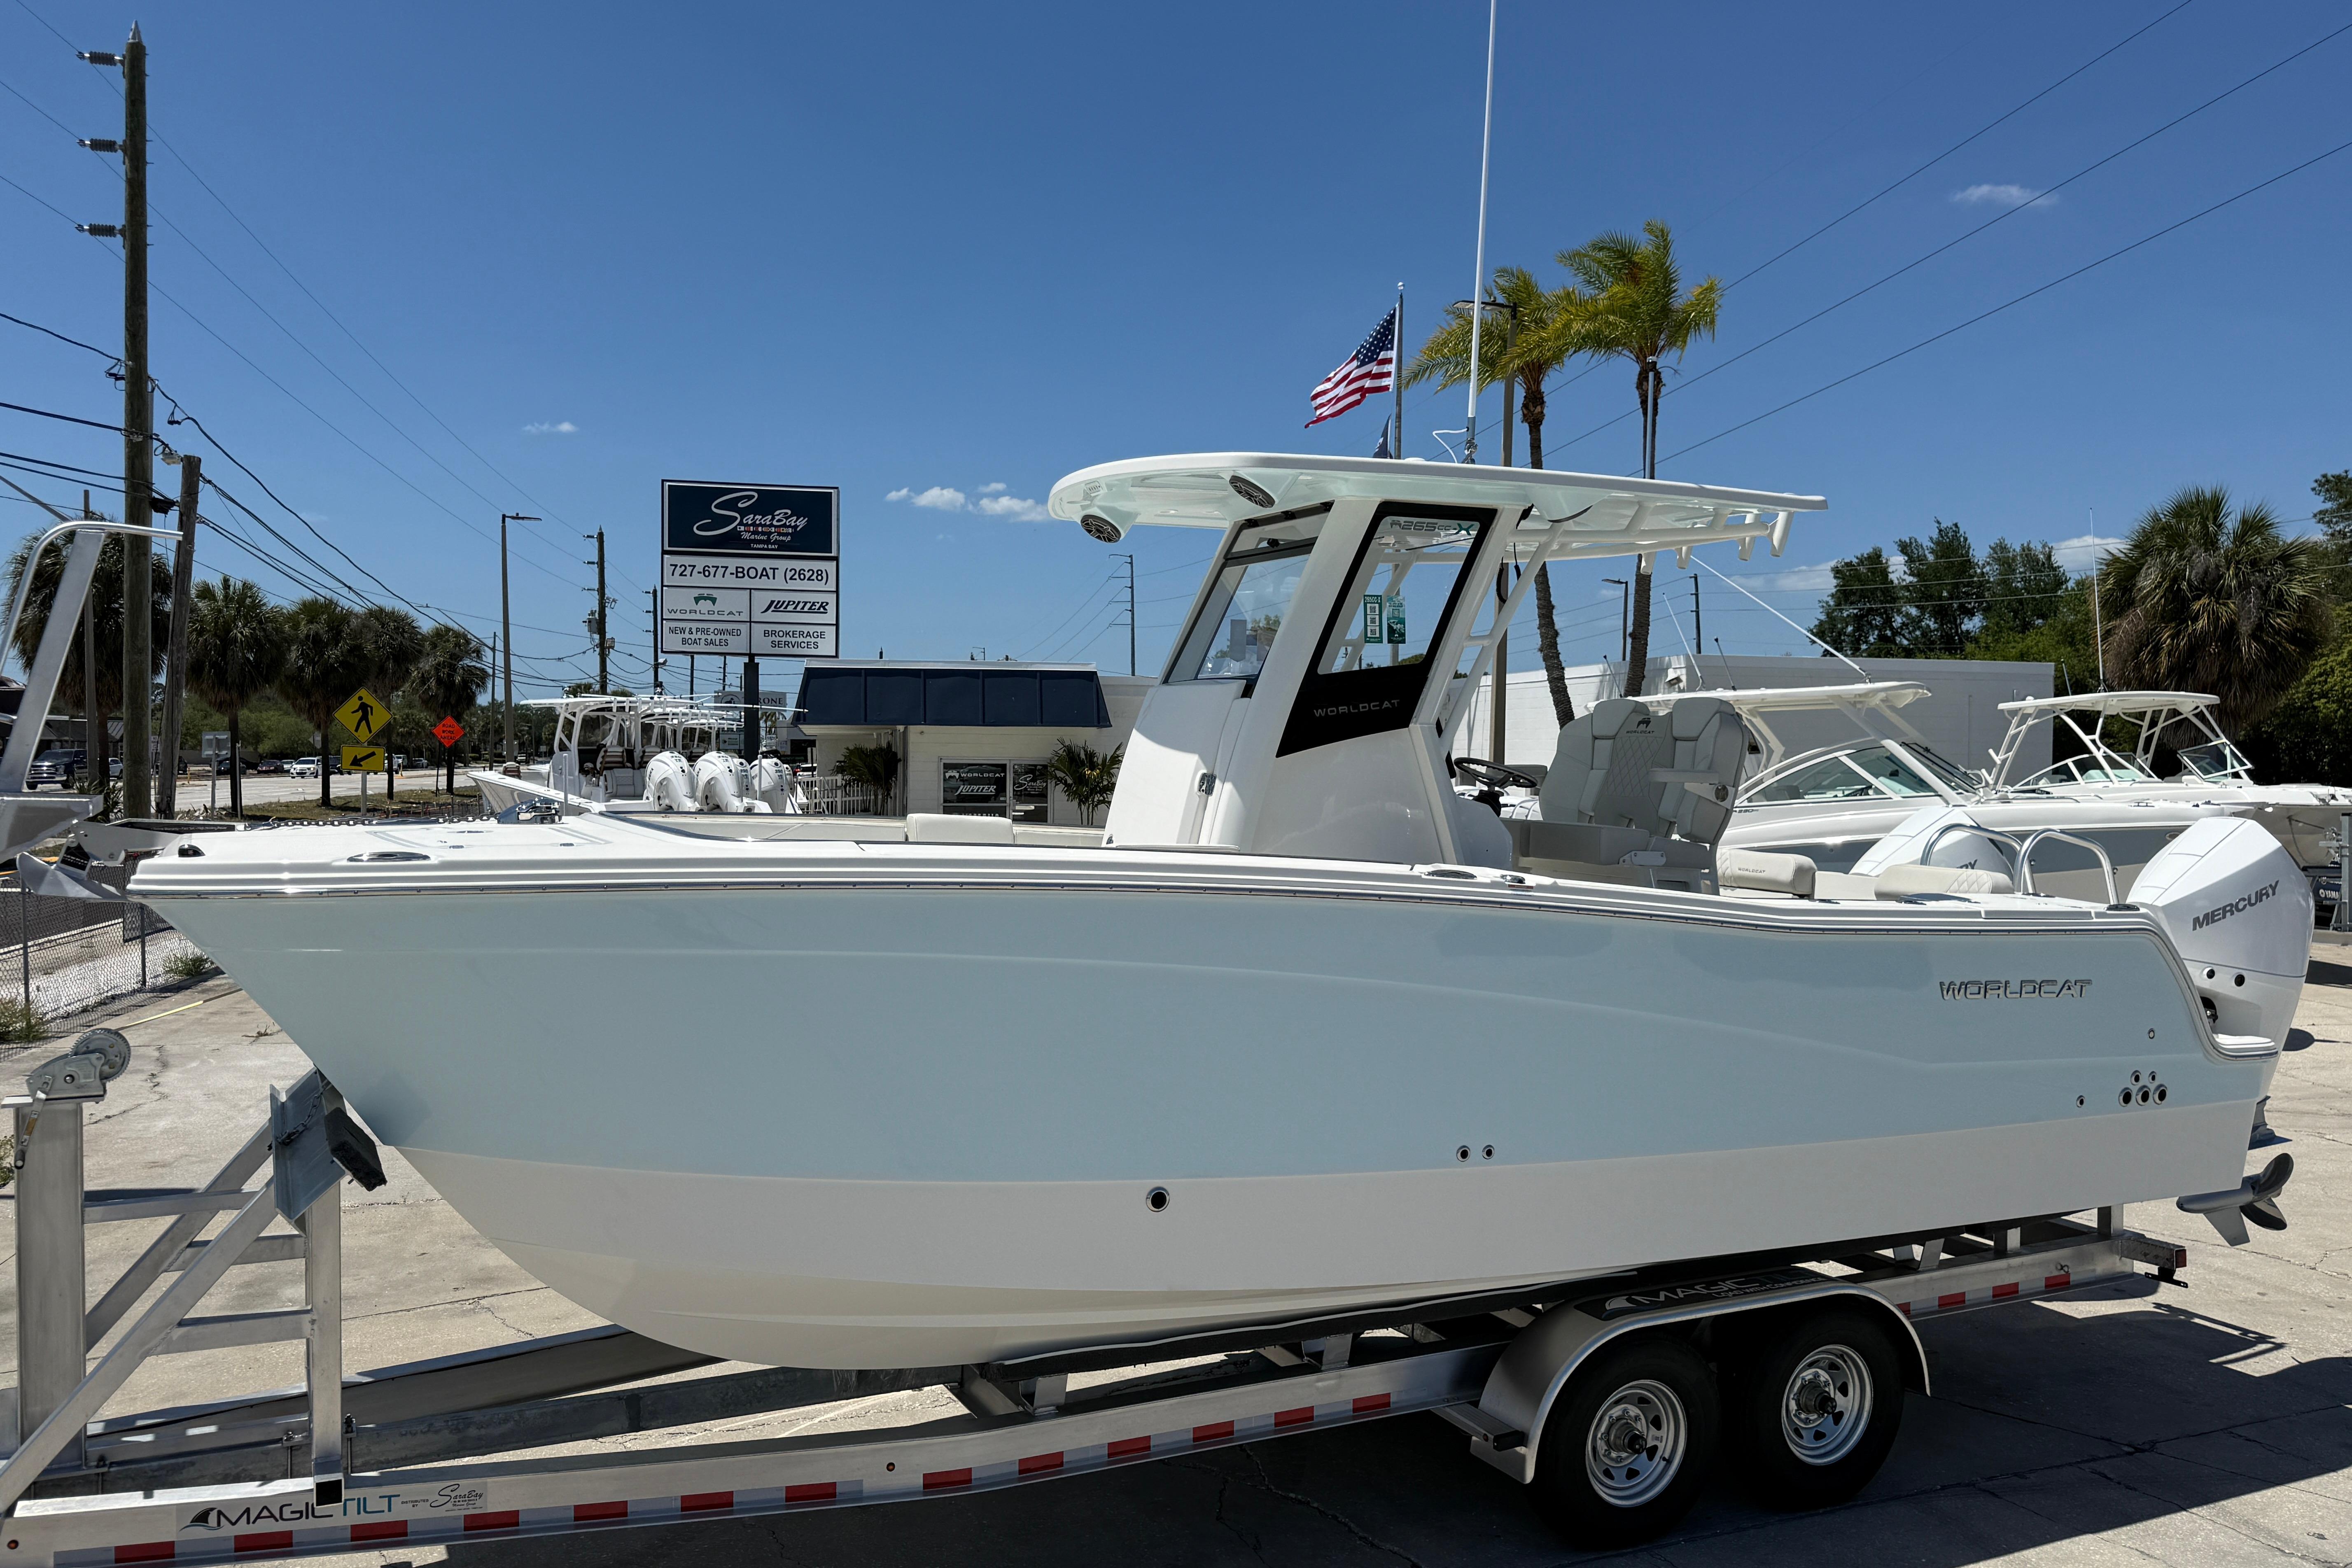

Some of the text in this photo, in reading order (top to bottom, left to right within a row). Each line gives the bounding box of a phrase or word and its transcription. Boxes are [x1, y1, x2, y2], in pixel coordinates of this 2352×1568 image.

[693, 491, 808, 536] SaraBay
[770, 533, 791, 542] Group
[670, 564, 828, 585] 727-677-BOAT (2628)
[667, 608, 744, 616] WORLDCAT
[761, 600, 829, 614] JUPITER
[669, 627, 686, 635] NEW
[696, 628, 741, 637] PRE-OWNED
[763, 630, 826, 639] BROKERAGE
[771, 640, 819, 649] SERVICES
[1314, 699, 1400, 717] WORLDCAT
[954, 785, 996, 795] JUPITER
[2192, 880, 2279, 931] MERCURY
[1939, 979, 2093, 1000] WORLDCAT
[429, 1484, 483, 1508] SaraBay
